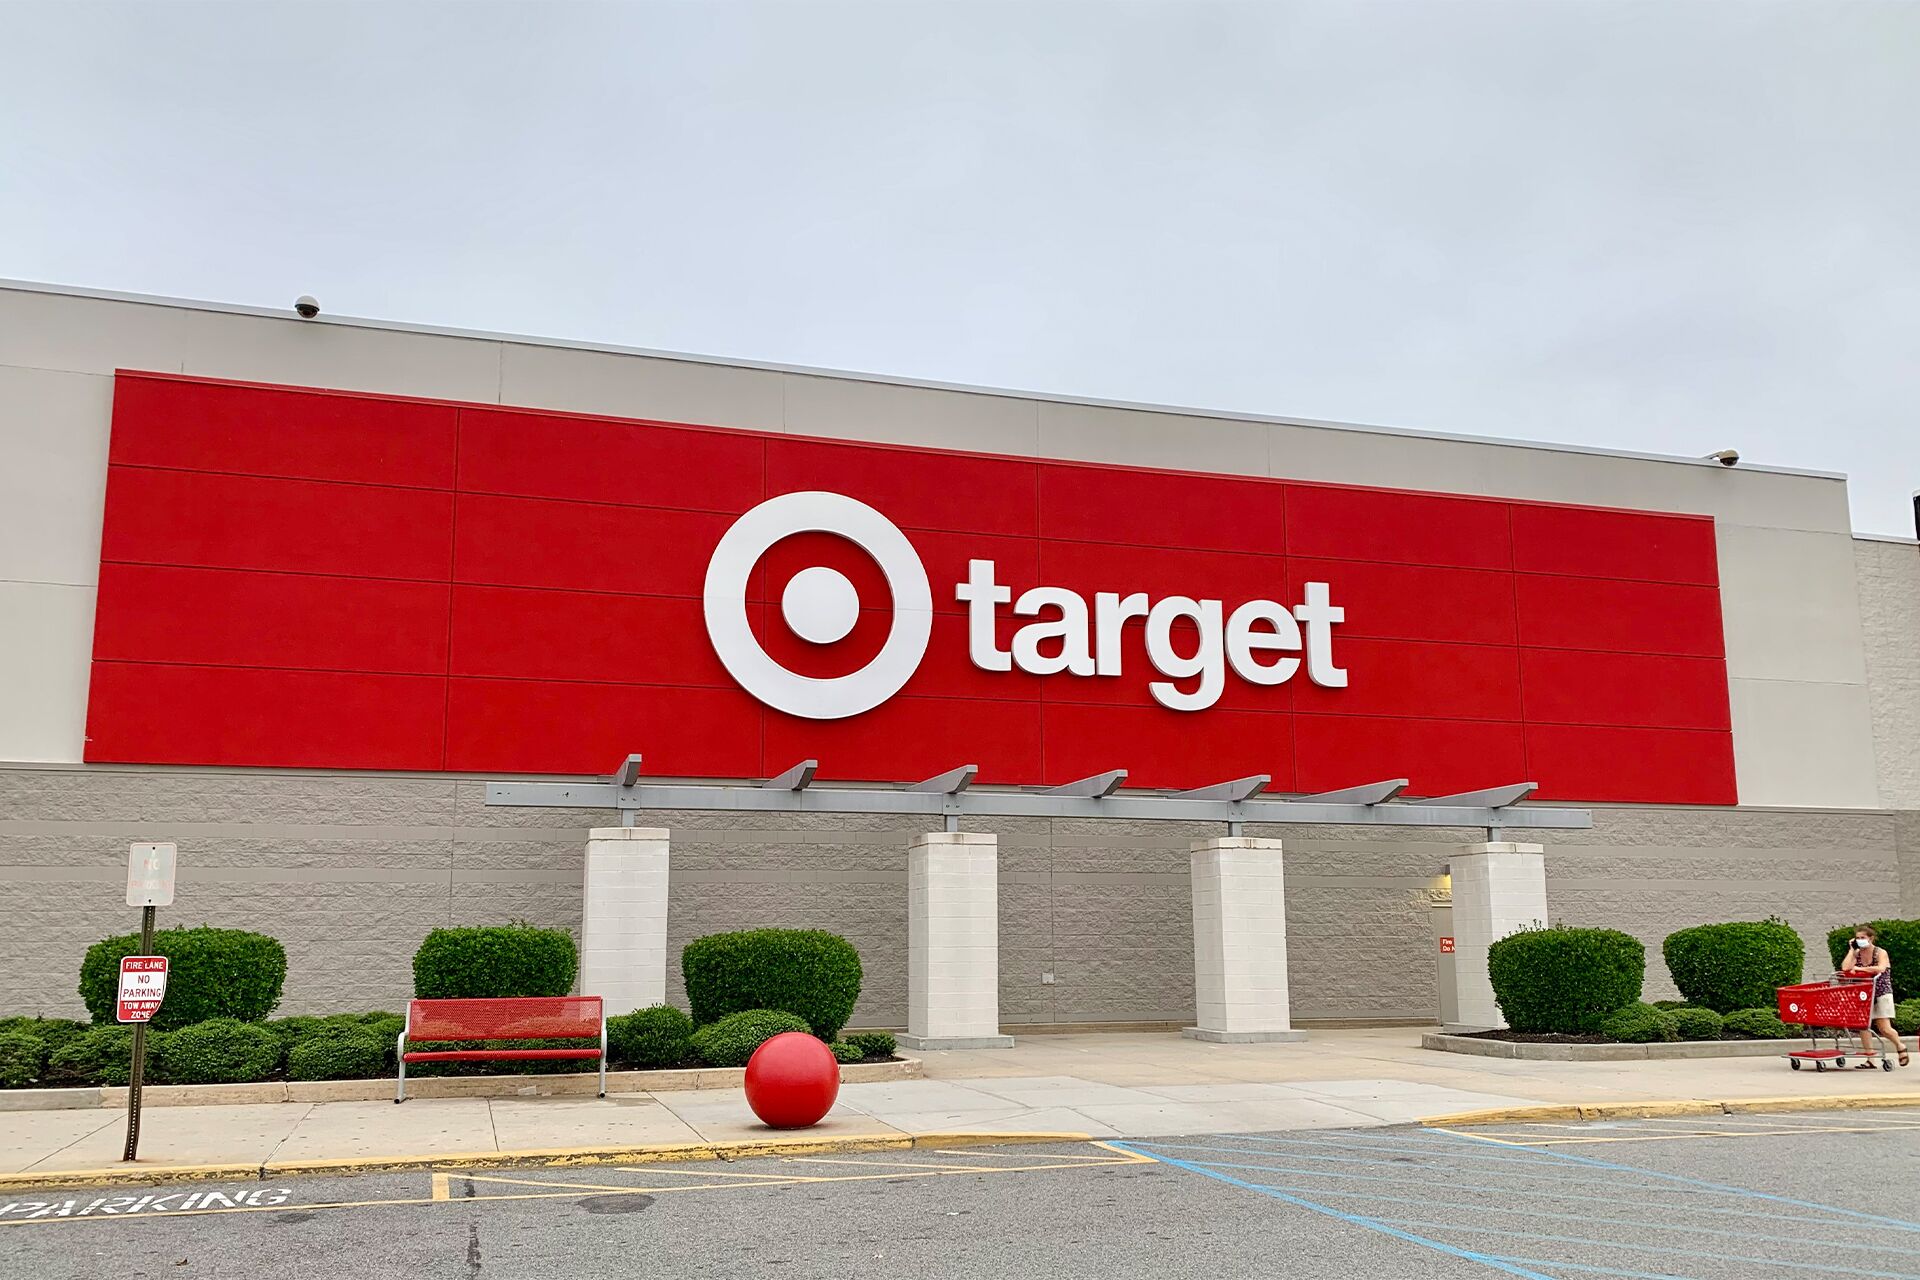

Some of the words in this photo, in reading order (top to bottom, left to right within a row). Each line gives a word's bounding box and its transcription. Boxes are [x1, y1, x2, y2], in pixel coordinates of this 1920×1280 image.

[955, 559, 1348, 712] target
[125, 961, 142, 970] FIRE
[144, 961, 164, 970] LANE
[137, 975, 150, 984] NO
[123, 988, 162, 998] PARKING
[123, 1001, 139, 1010] TOW
[140, 1001, 159, 1010] AWAY
[130, 1010, 151, 1019] ZONE
[0, 1188, 292, 1219] PARKING
